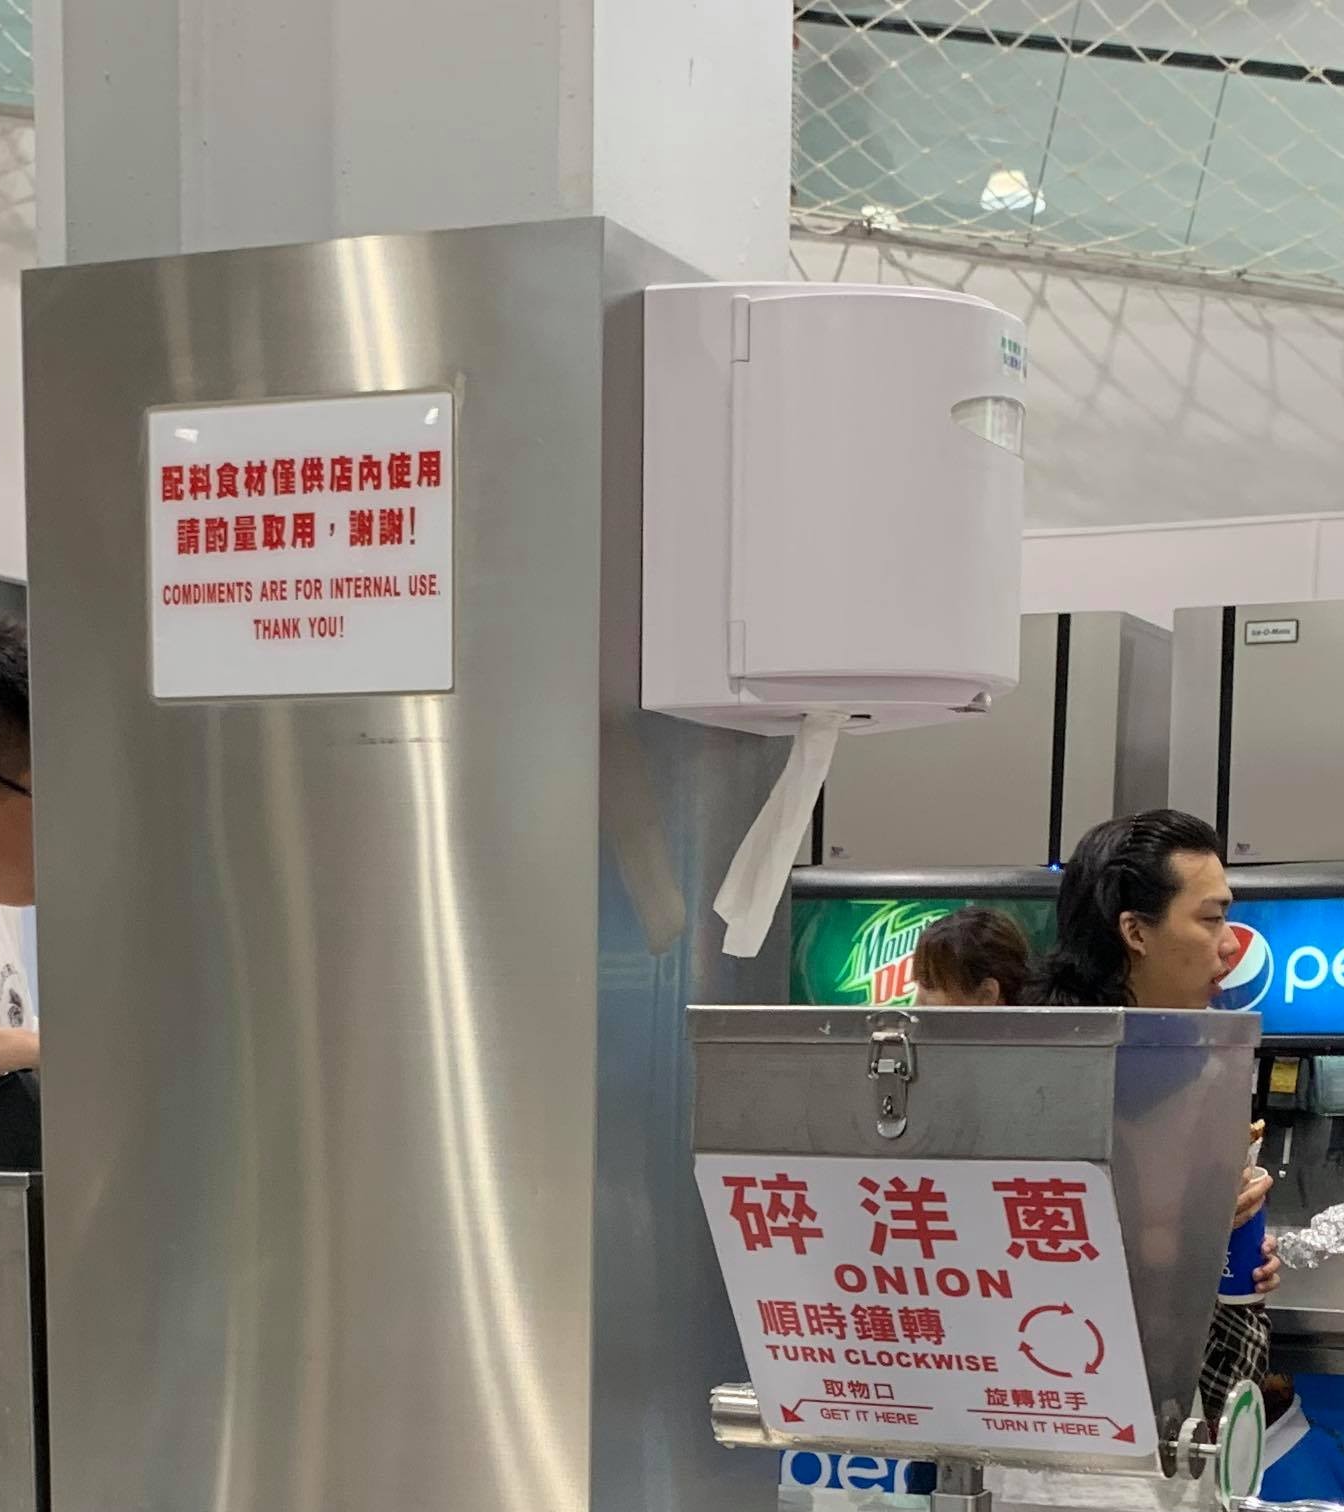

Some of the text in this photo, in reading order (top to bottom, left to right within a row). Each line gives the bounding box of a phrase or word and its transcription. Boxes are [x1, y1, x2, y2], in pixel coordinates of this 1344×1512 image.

[161, 450, 442, 502] 配料食材僅供店內使用
[163, 581, 253, 605] COMDIMENTS
[260, 579, 287, 602] ARE
[295, 578, 323, 600] FOR
[330, 575, 401, 599] INTERNAL
[254, 616, 344, 640] THANK YOU!
[722, 1173, 1100, 1263] 碎洋蔥
[834, 1263, 1014, 1299] ONION
[758, 1300, 946, 1346] 順時鐘轉
[766, 1344, 999, 1373] TURN CLOCKWISE
[822, 1379, 895, 1401] 取物口
[984, 1387, 1088, 1411] 旋轉把手
[821, 1408, 919, 1425] GET IT HERE
[982, 1418, 1100, 1437] TURN IT HERE
